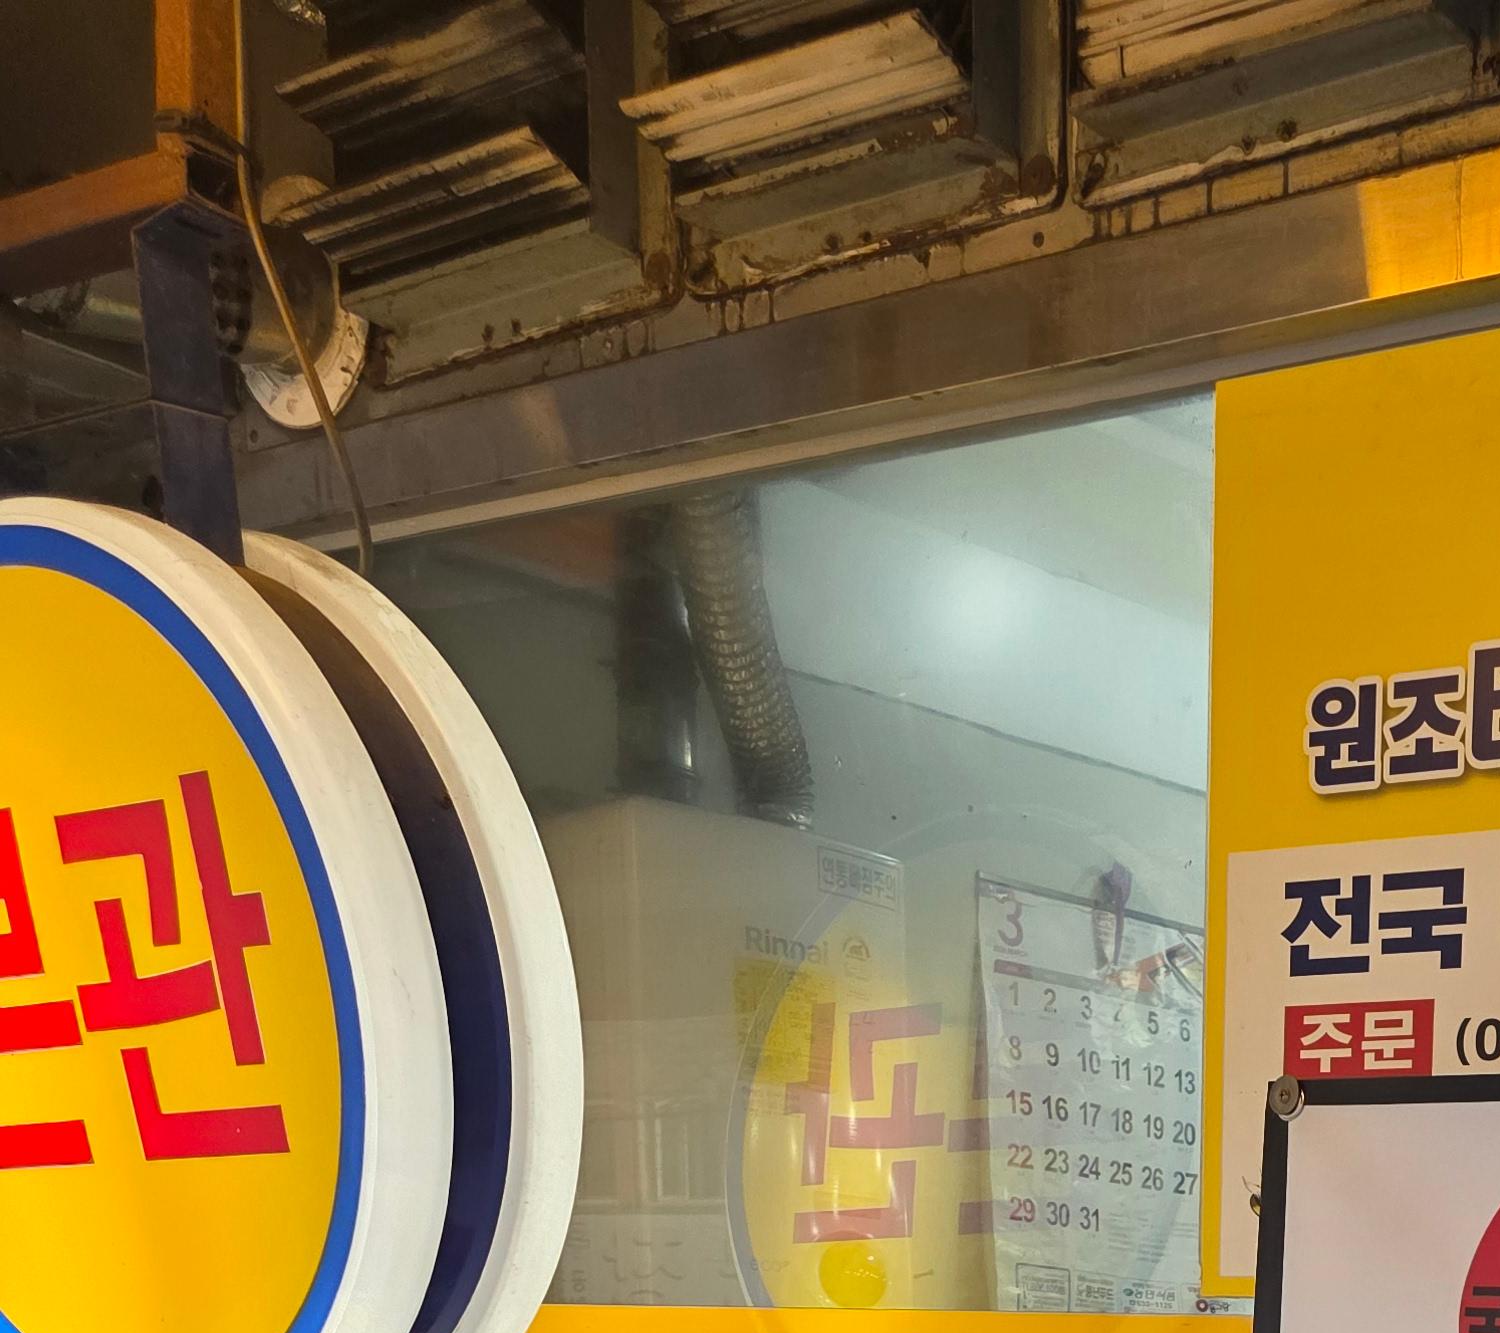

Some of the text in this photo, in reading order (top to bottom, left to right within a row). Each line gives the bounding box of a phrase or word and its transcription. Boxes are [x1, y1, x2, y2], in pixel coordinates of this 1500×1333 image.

[744, 925, 830, 965] Rinnai
[1280, 867, 1466, 978] 전국
[1298, 1010, 1416, 1073] 주문
[1041, 1094, 1069, 1122] 16
